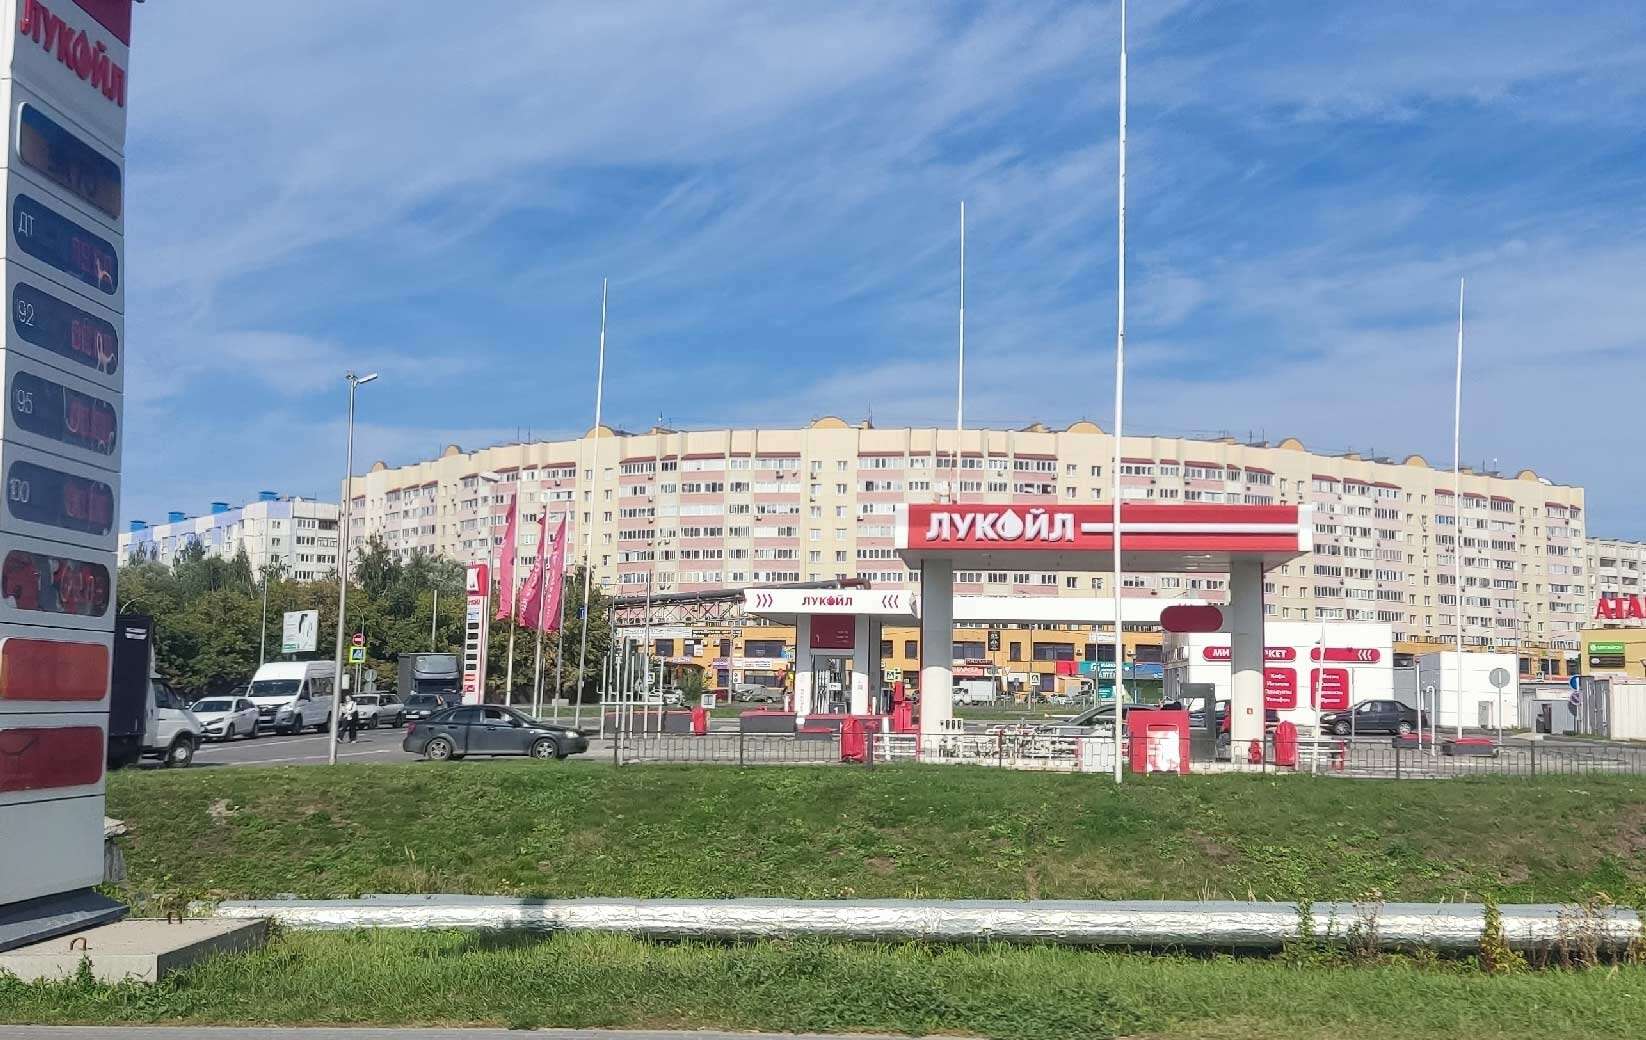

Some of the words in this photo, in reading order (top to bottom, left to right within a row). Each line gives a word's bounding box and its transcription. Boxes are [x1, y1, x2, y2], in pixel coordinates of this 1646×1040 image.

[21, 0, 124, 107] ЛУКОЙЛ
[18, 211, 34, 236] ДТ
[18, 300, 34, 326] 92
[926, 508, 1075, 542] ЛУКОЙЛ
[802, 595, 853, 606] ЛУКОЙЛ
[1595, 594, 1646, 619] АТА
